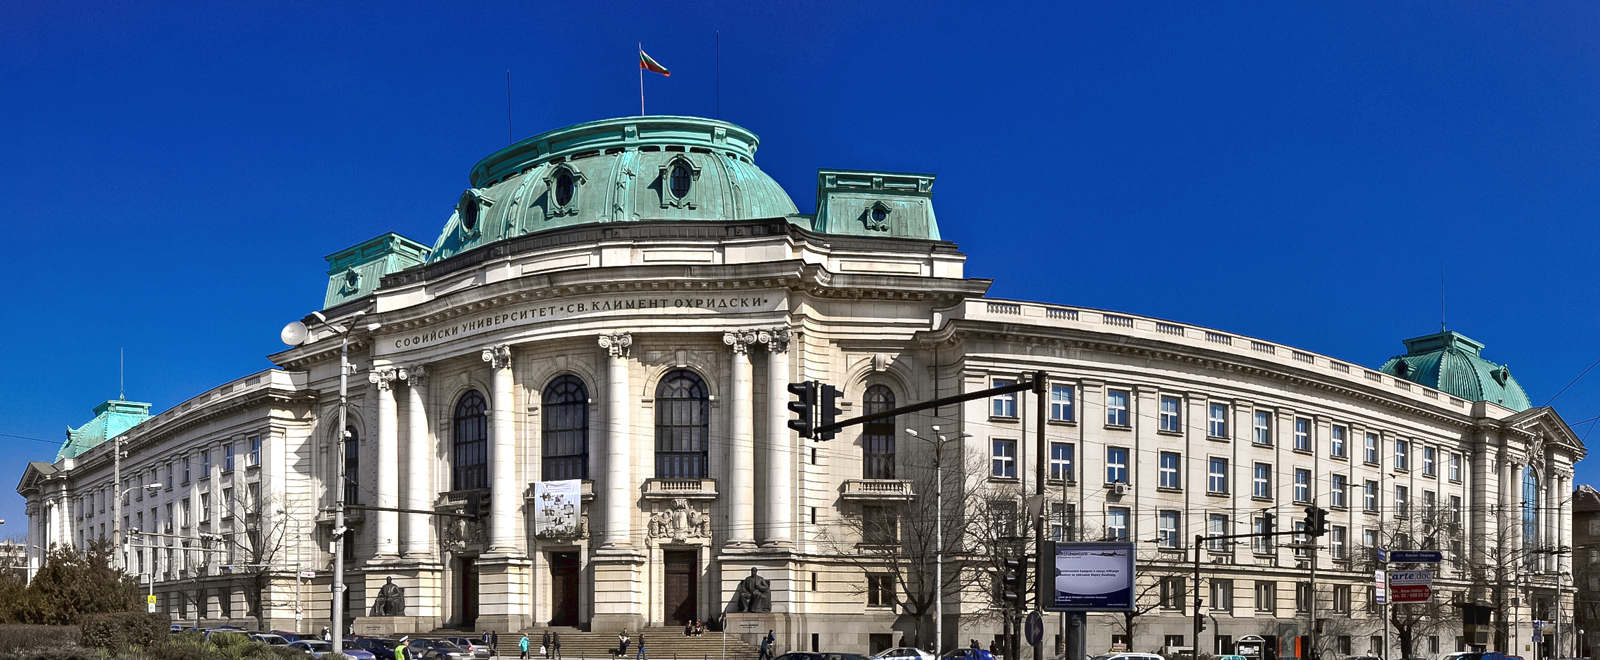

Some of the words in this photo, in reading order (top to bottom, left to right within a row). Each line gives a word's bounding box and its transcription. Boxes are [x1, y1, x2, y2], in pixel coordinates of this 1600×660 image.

[395, 326, 459, 348] СОФИЙСКИ
[462, 306, 556, 333] УНИВЕРСИТЕТ
[592, 299, 668, 311] КЛИМЕНТ
[674, 297, 761, 308] ОХРИДСКИ
